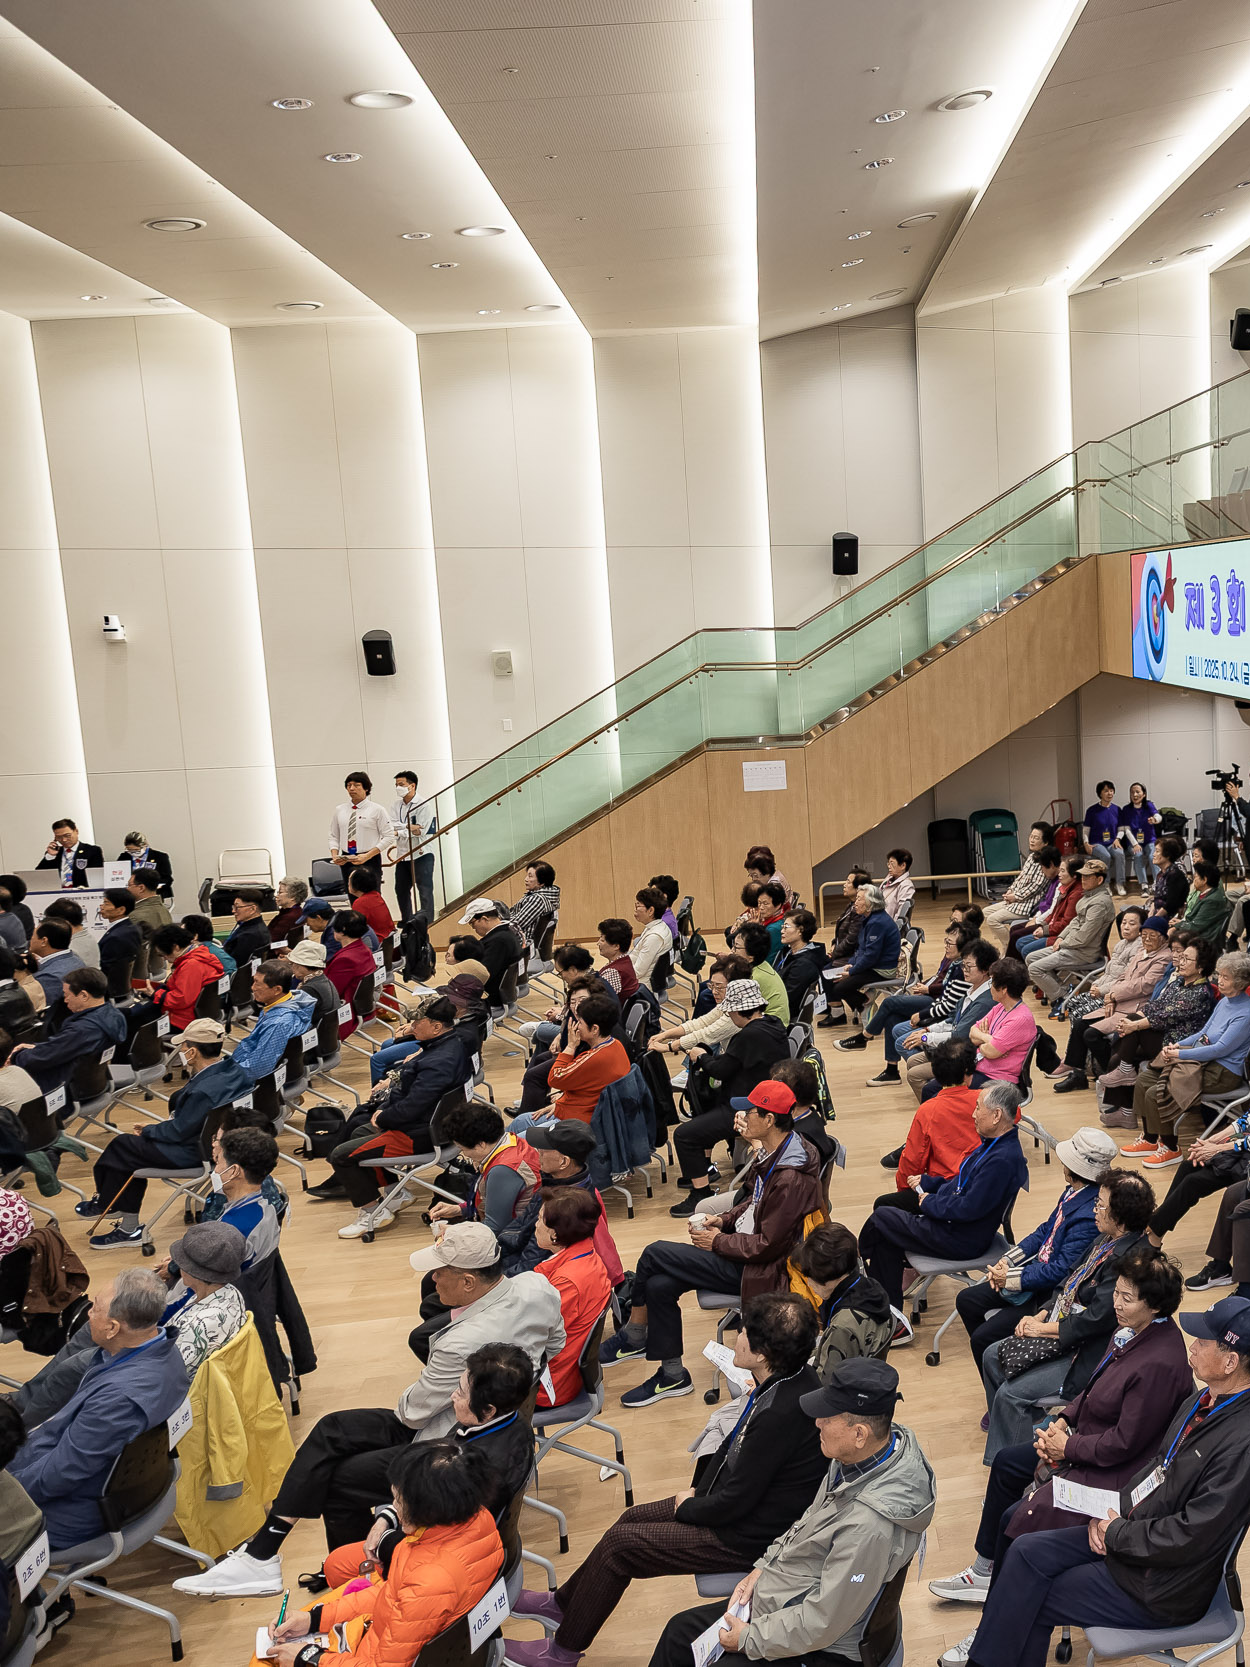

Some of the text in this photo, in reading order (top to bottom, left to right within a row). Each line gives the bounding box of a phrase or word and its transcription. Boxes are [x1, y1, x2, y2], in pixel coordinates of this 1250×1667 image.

[22, 1547, 47, 1584] 2조 6번
[472, 1592, 507, 1635] 10조 1번
